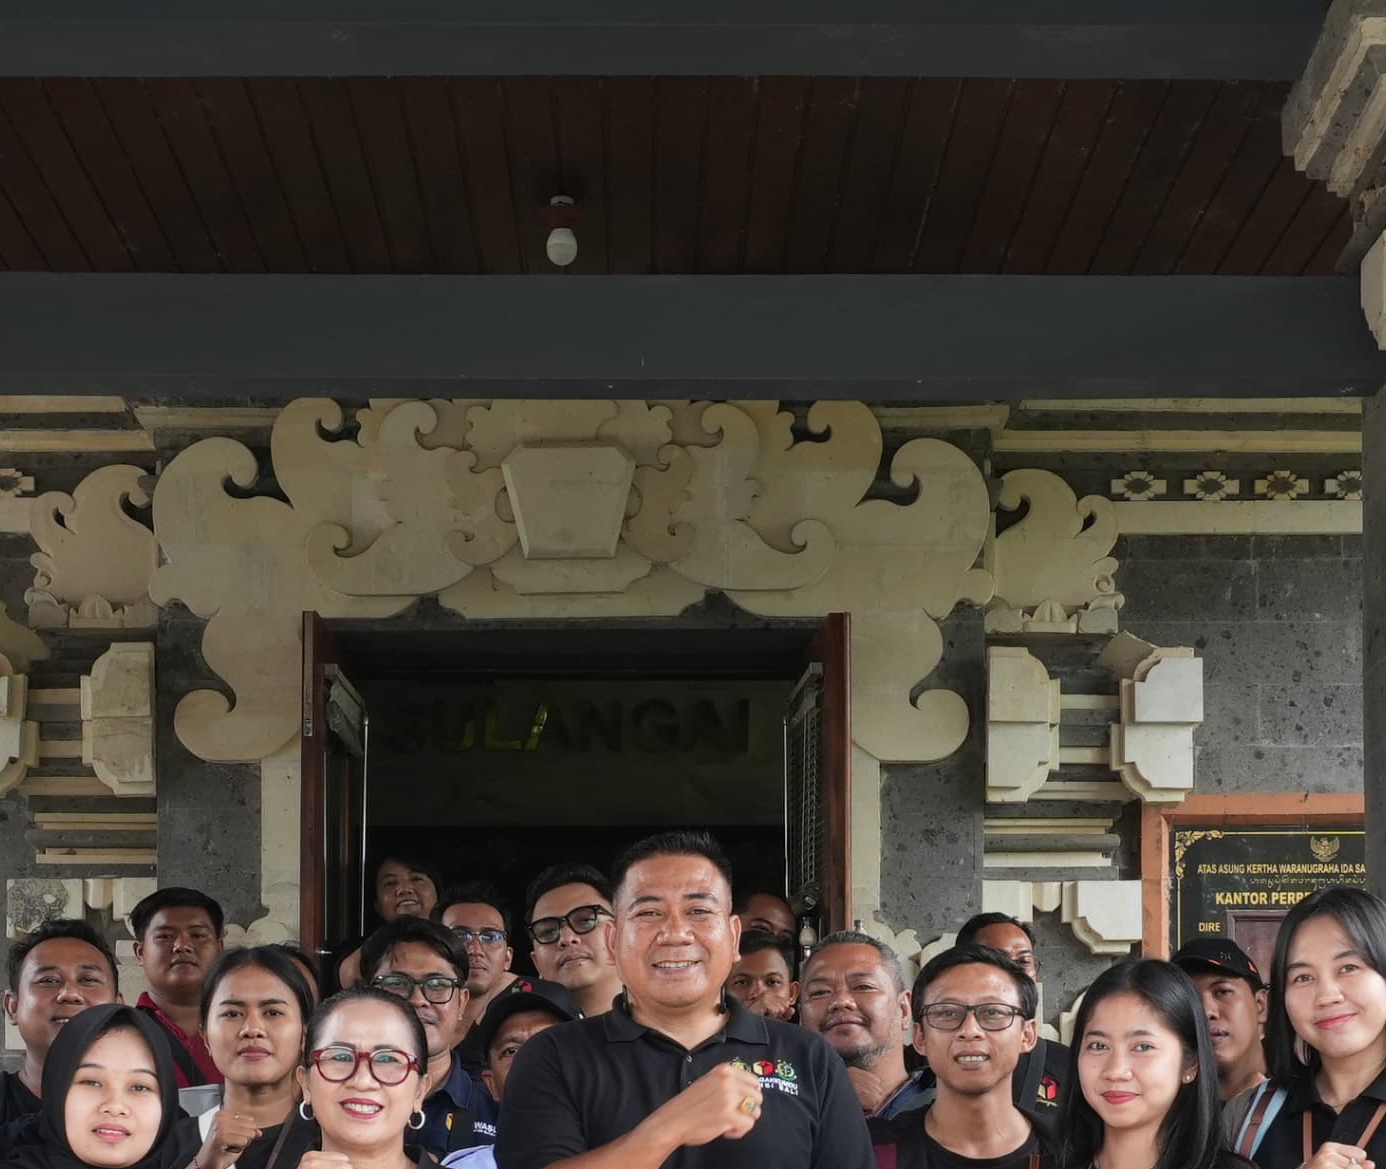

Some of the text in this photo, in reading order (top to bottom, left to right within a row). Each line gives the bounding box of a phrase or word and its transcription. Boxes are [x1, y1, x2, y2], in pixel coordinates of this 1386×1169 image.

[381, 698, 750, 753] SULANGAI
[1198, 864, 1217, 874] ATAS
[1218, 864, 1245, 874] ASUNG
[1247, 864, 1278, 874] KERTHA
[1279, 863, 1340, 873] WARANUGRAHA
[1341, 863, 1355, 873] IDA
[1215, 891, 1268, 905] KANTOR
